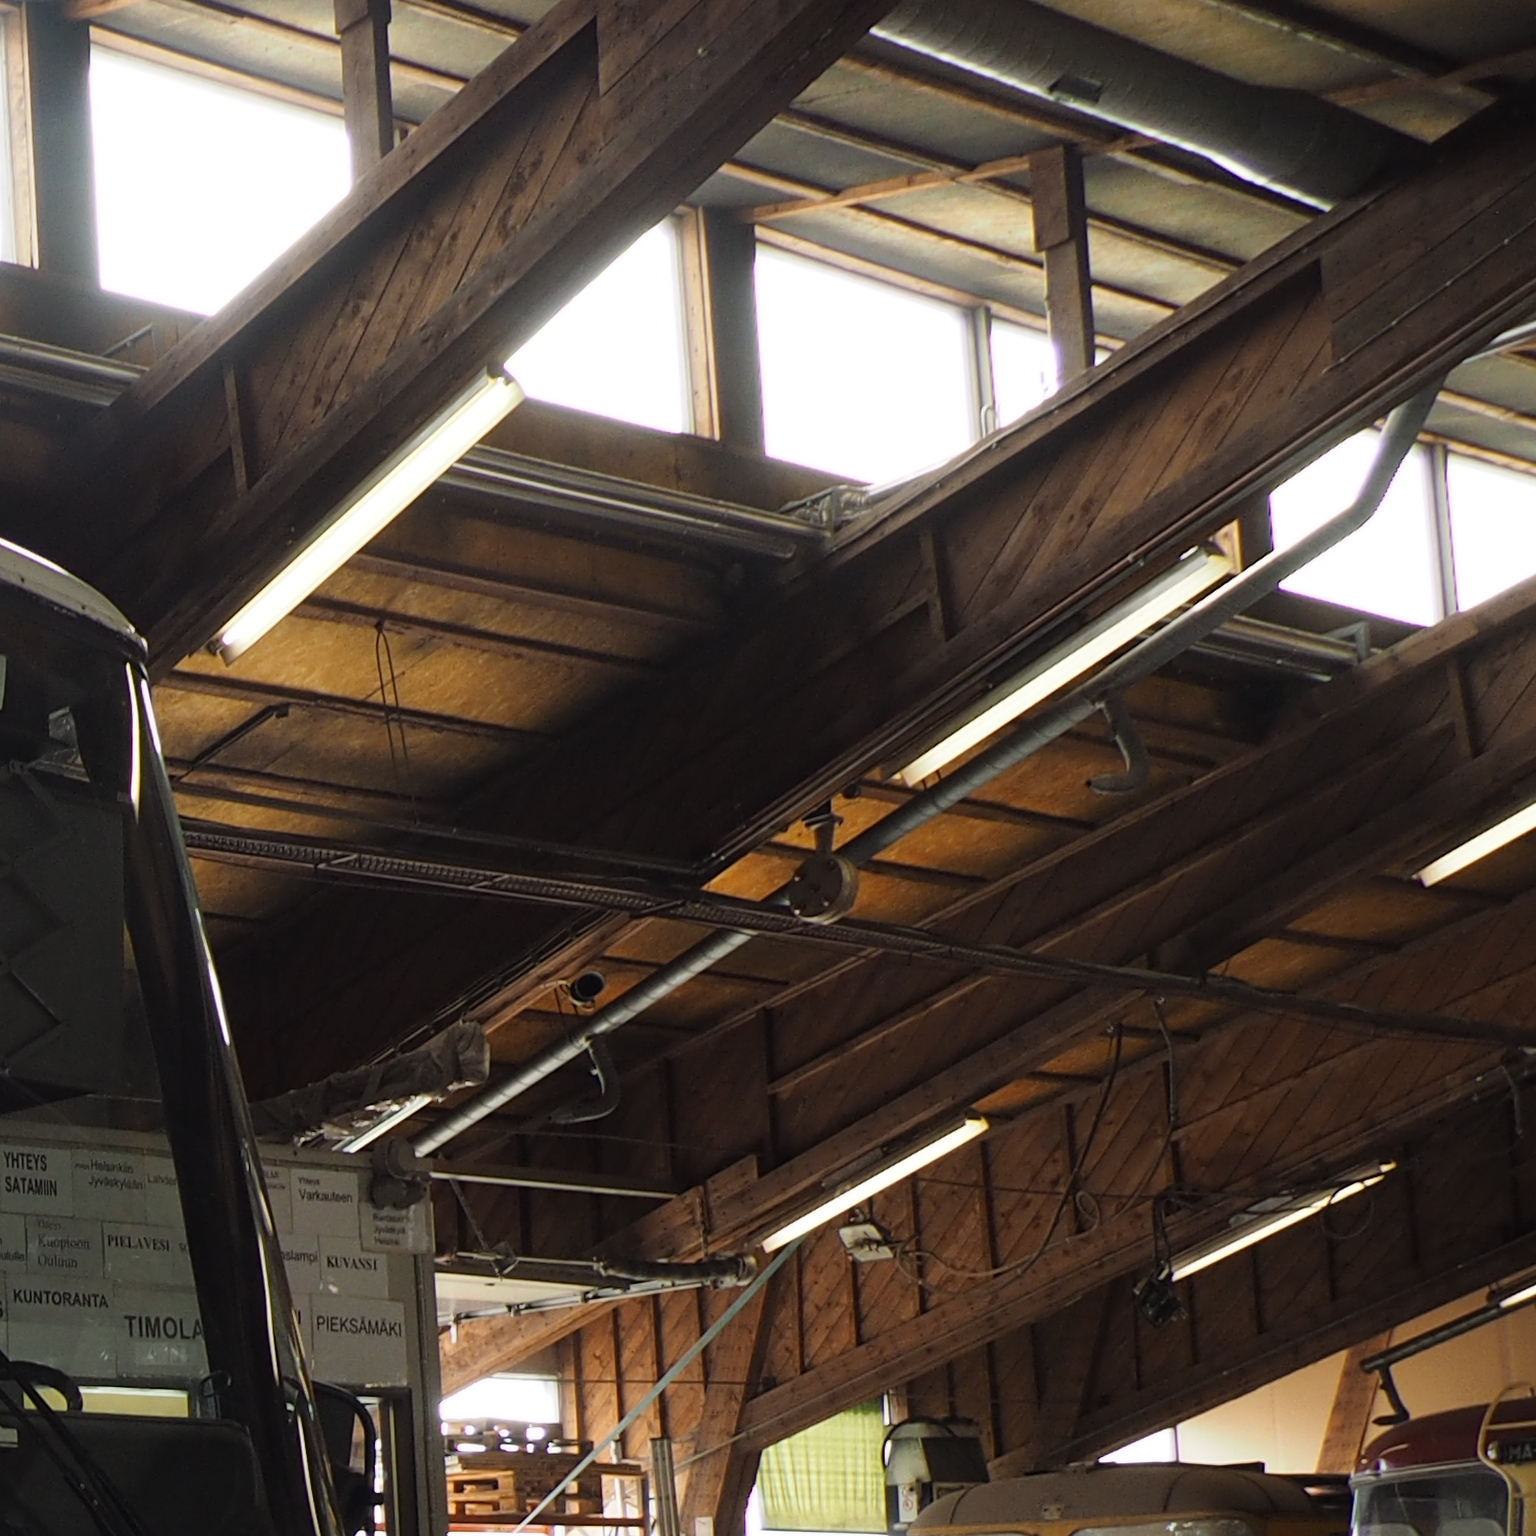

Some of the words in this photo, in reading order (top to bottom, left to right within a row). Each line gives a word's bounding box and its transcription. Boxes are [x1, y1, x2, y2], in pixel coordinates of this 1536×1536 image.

[3, 1151, 47, 1171] YHTEYS
[5, 1176, 57, 1197] SATAMIIN
[298, 1188, 353, 1203] Varkauteen
[37, 1234, 90, 1250] Kuopioon
[107, 1234, 170, 1252] PIELAVESI
[37, 1253, 77, 1268] Ouluun
[326, 1256, 378, 1271] KUVANSI
[13, 1289, 109, 1309] KUNTORANTA
[124, 1315, 203, 1340] TIMOLA
[316, 1314, 403, 1338] PIEKSÄMÄKI
